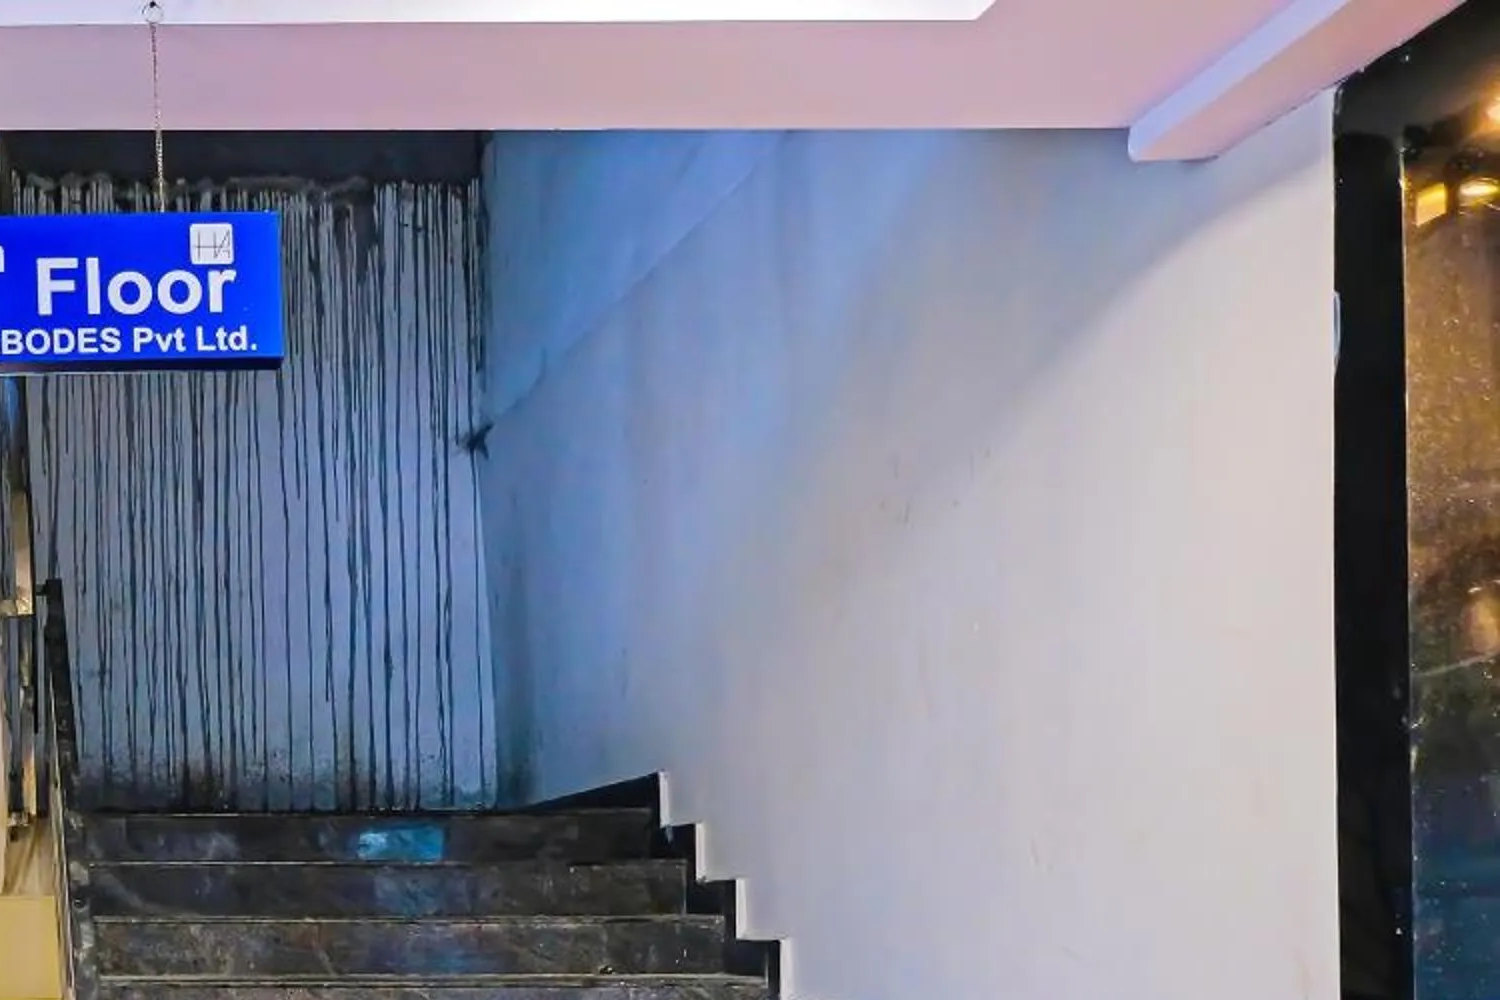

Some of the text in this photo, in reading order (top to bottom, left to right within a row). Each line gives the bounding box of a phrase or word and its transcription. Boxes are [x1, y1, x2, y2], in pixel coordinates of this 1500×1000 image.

[36, 257, 237, 316] Floor
[133, 327, 186, 353] Pvt
[196, 325, 257, 352] Ltd.
